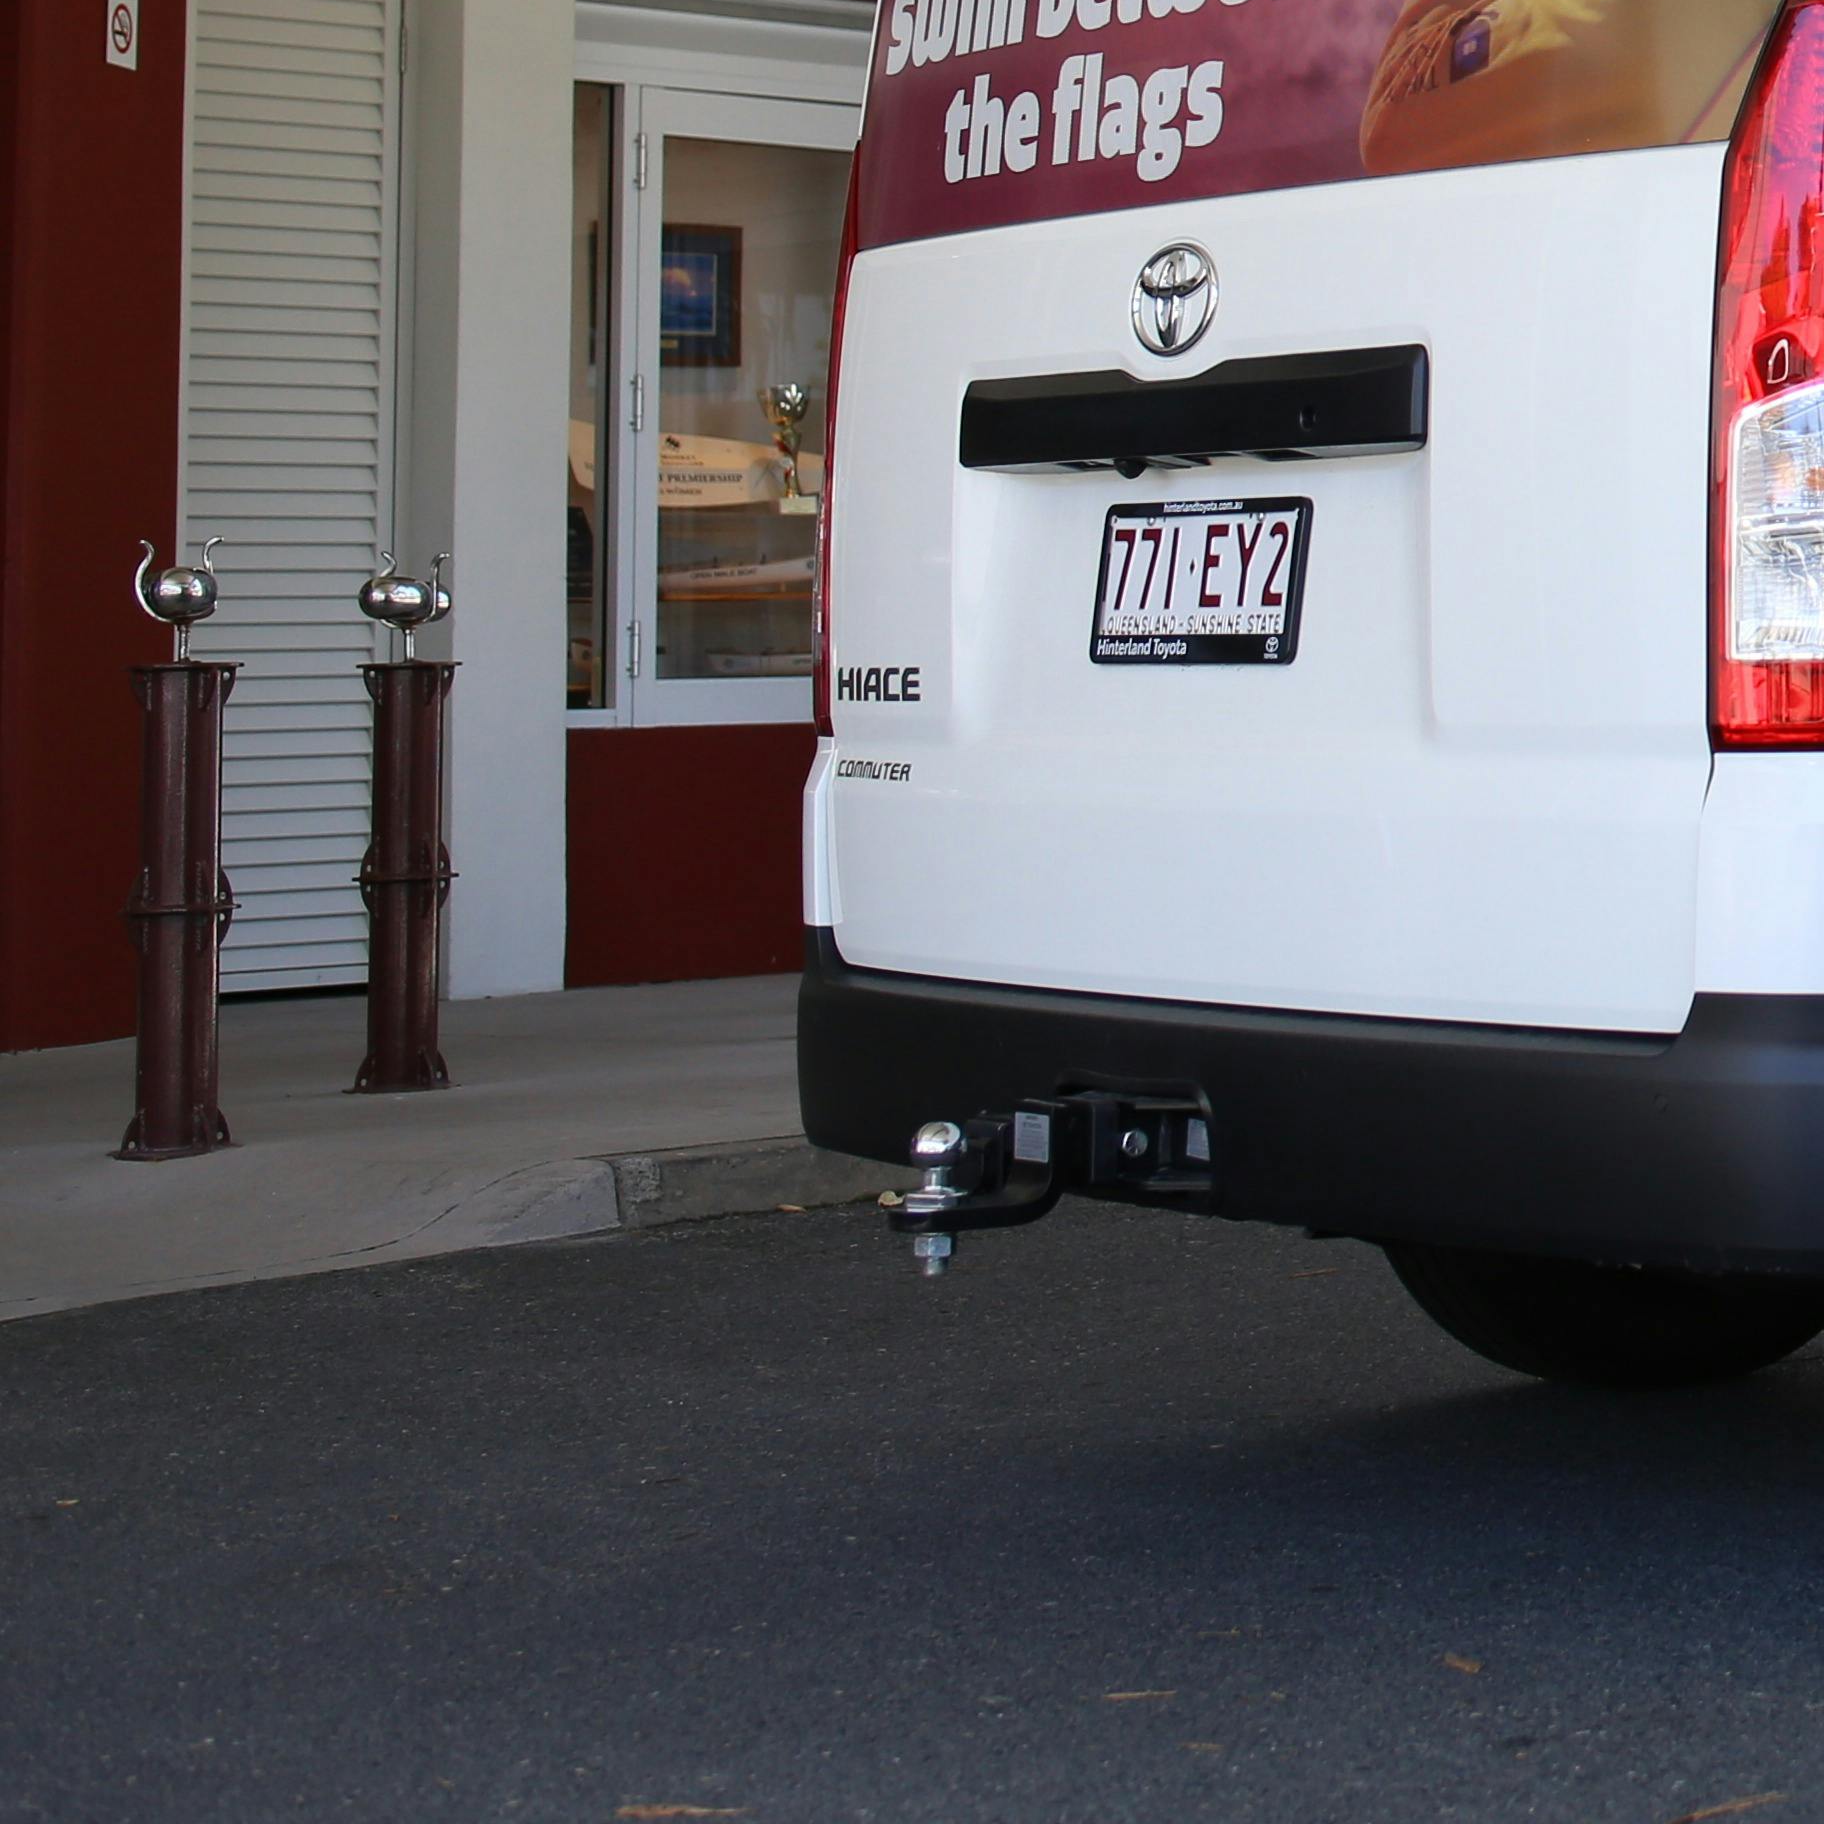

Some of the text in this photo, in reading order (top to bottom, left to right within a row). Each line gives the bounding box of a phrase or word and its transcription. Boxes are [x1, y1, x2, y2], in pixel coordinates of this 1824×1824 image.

[943, 52, 1226, 185] the flags
[1163, 500, 1244, 514] hinterlandtoyota.com.au
[1113, 521, 1290, 611] 771 EY2
[1106, 615, 1177, 635] QUEENSLAND
[1187, 614, 1242, 635] SUNSHINE
[1247, 613, 1283, 634] STATE
[1096, 637, 1188, 660] Hinterland Toyota
[837, 666, 921, 702] HIACE
[837, 759, 912, 782] COMMUTER
